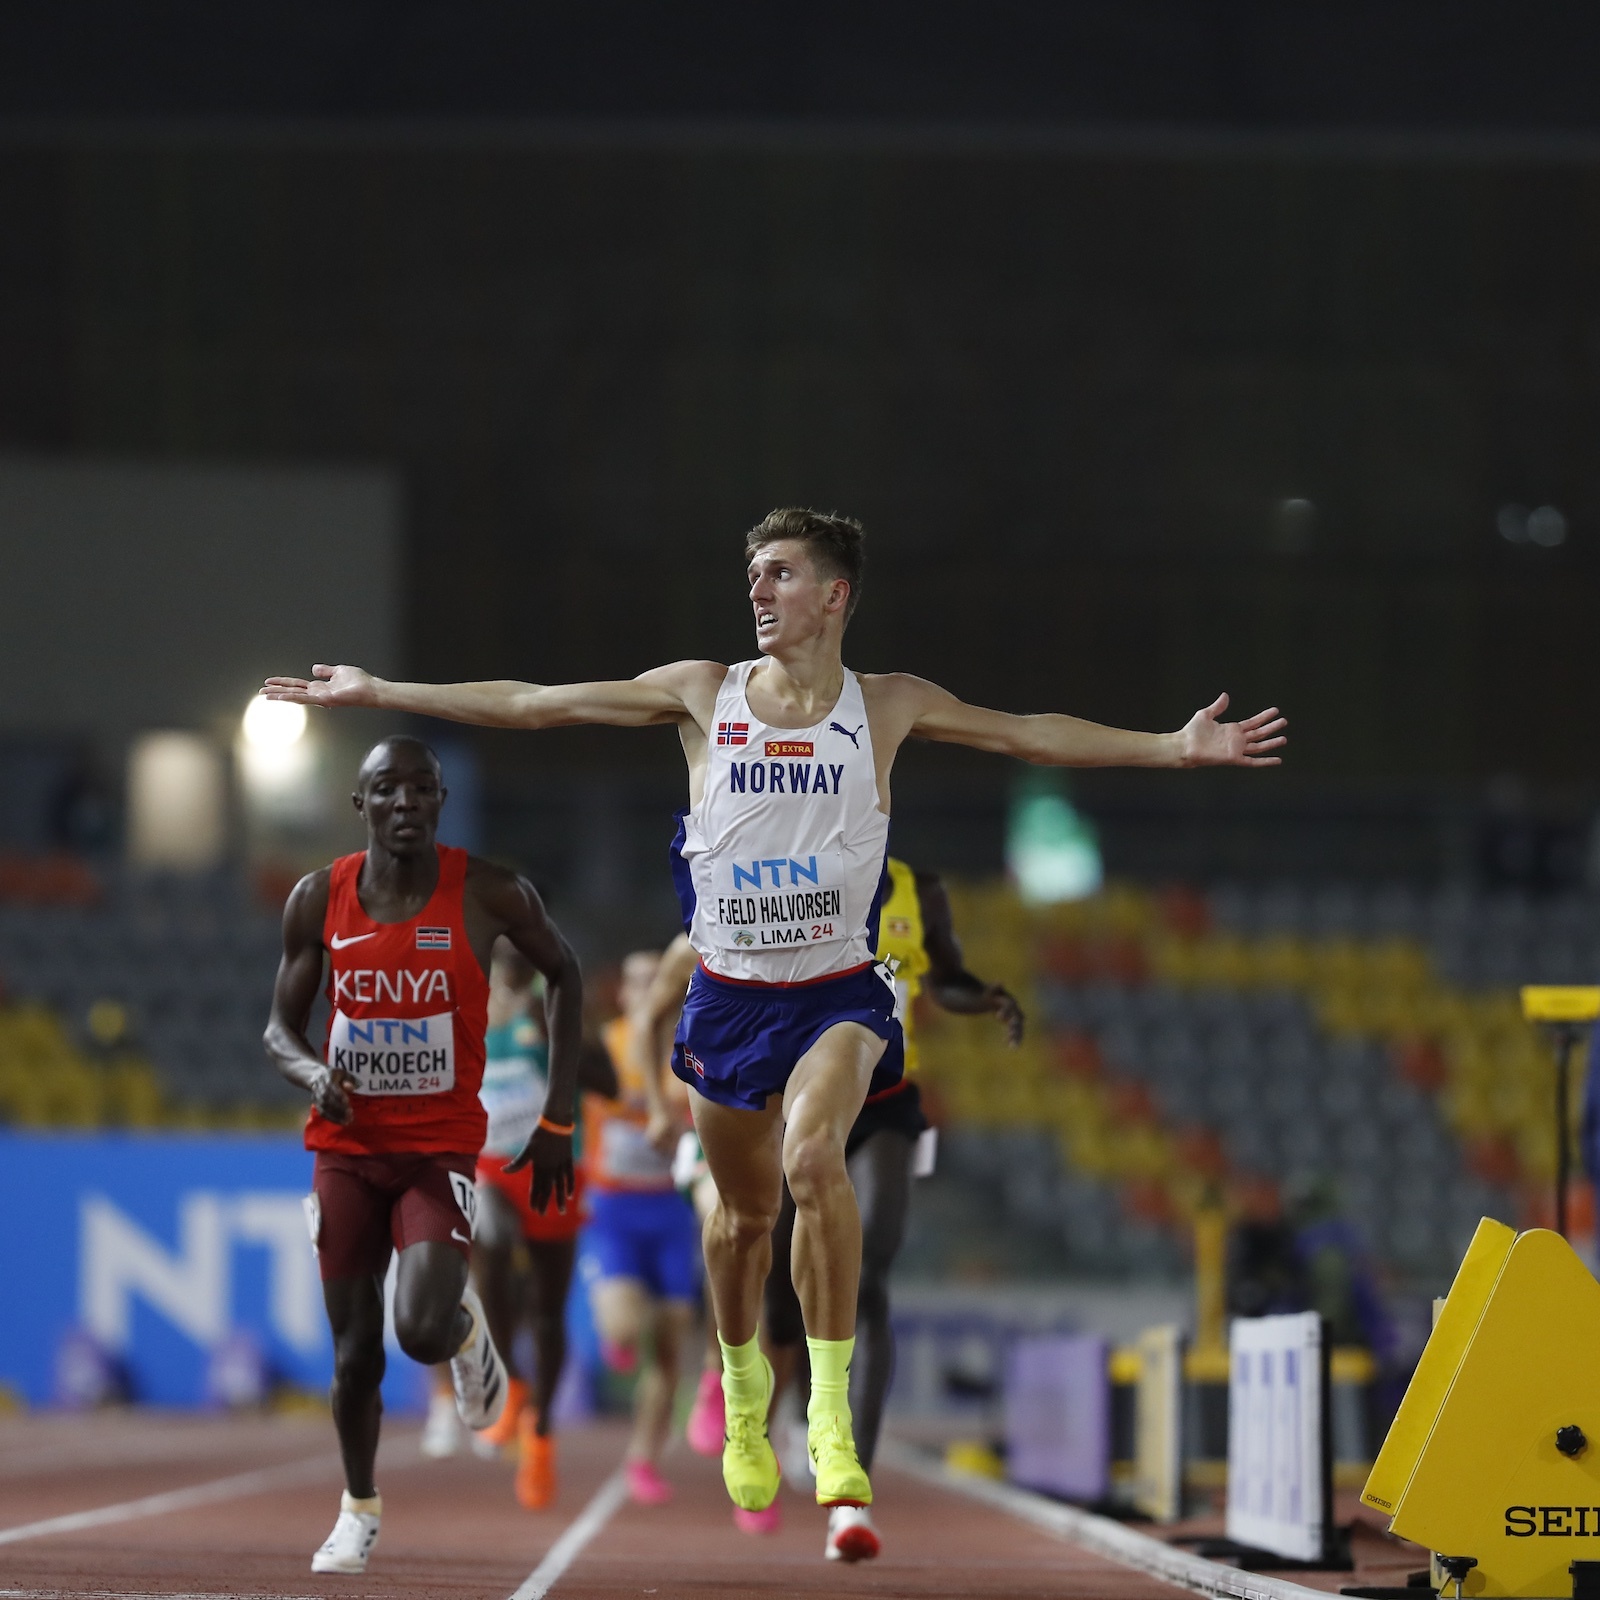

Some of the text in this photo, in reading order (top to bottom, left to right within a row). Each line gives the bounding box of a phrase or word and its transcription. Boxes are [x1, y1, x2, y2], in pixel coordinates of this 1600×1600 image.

[782, 745, 811, 753] EXTRA
[730, 762, 845, 795] NORWAY
[732, 855, 819, 891] NTN
[719, 889, 840, 926] FJELD HALVORSEN
[761, 923, 833, 945] LIMA 24
[333, 969, 449, 1003] KENYA
[348, 1020, 428, 1045] NTN
[334, 1047, 446, 1075] KIPKOECH
[369, 1077, 440, 1091] LIMA 24
[1366, 1494, 1391, 1508] SEIKO
